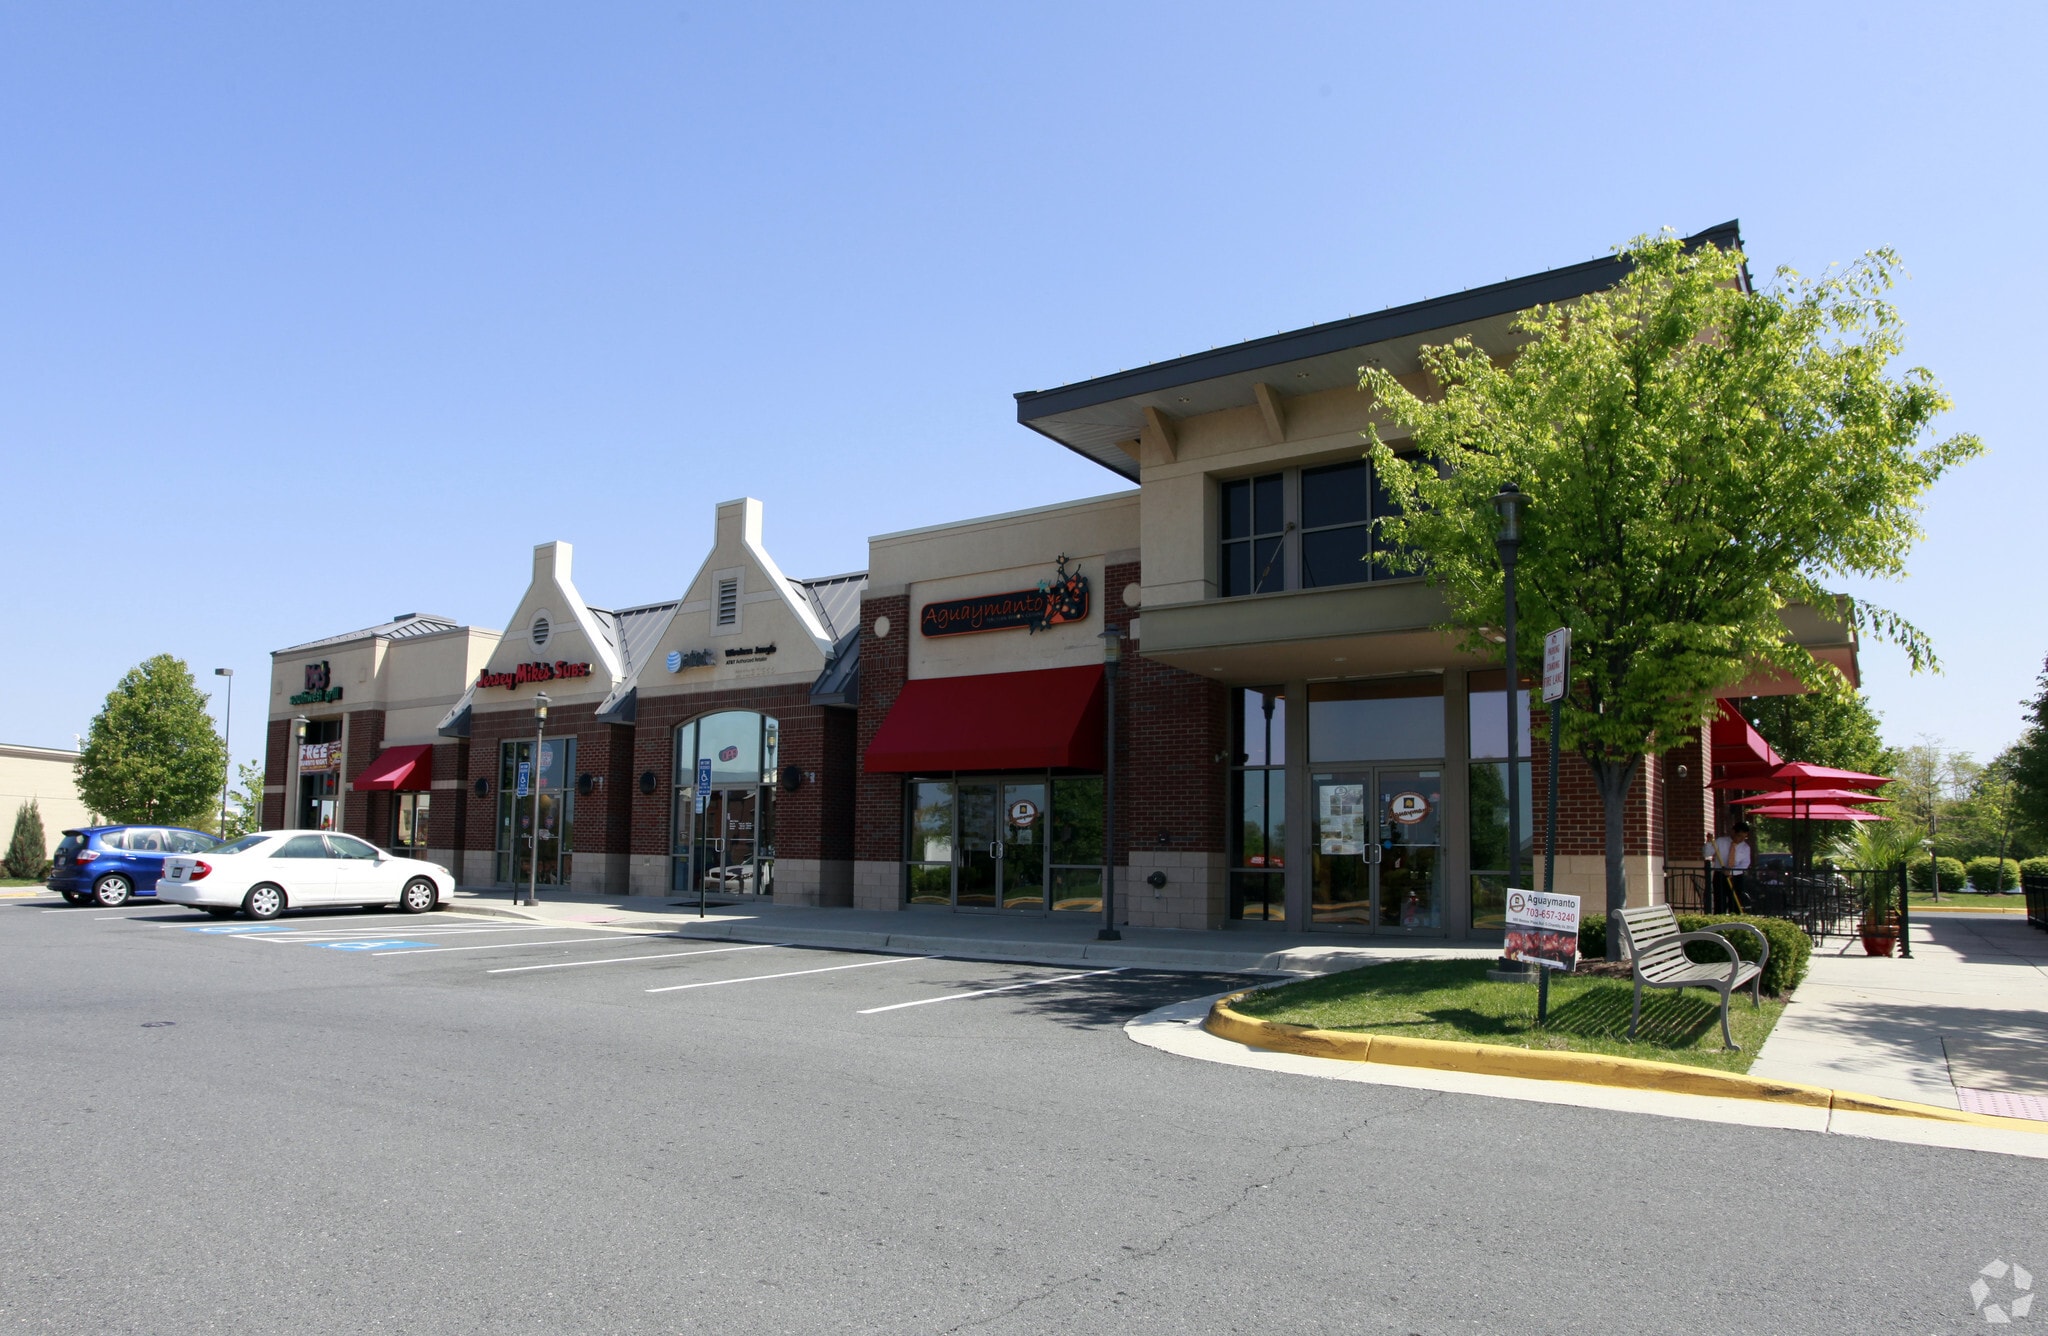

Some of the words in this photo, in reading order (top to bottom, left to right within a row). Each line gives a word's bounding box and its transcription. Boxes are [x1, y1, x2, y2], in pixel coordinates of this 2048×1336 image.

[922, 594, 1043, 629] Aguaymanto
[476, 668, 517, 690] Jersey
[516, 661, 554, 683] Mike's
[1543, 675, 1552, 687] FIRE
[1552, 671, 1563, 685] LANE
[299, 743, 329, 760] FREE
[1527, 894, 1576, 908] Aguaymanto
[1526, 908, 1575, 922] 703-657-3240
